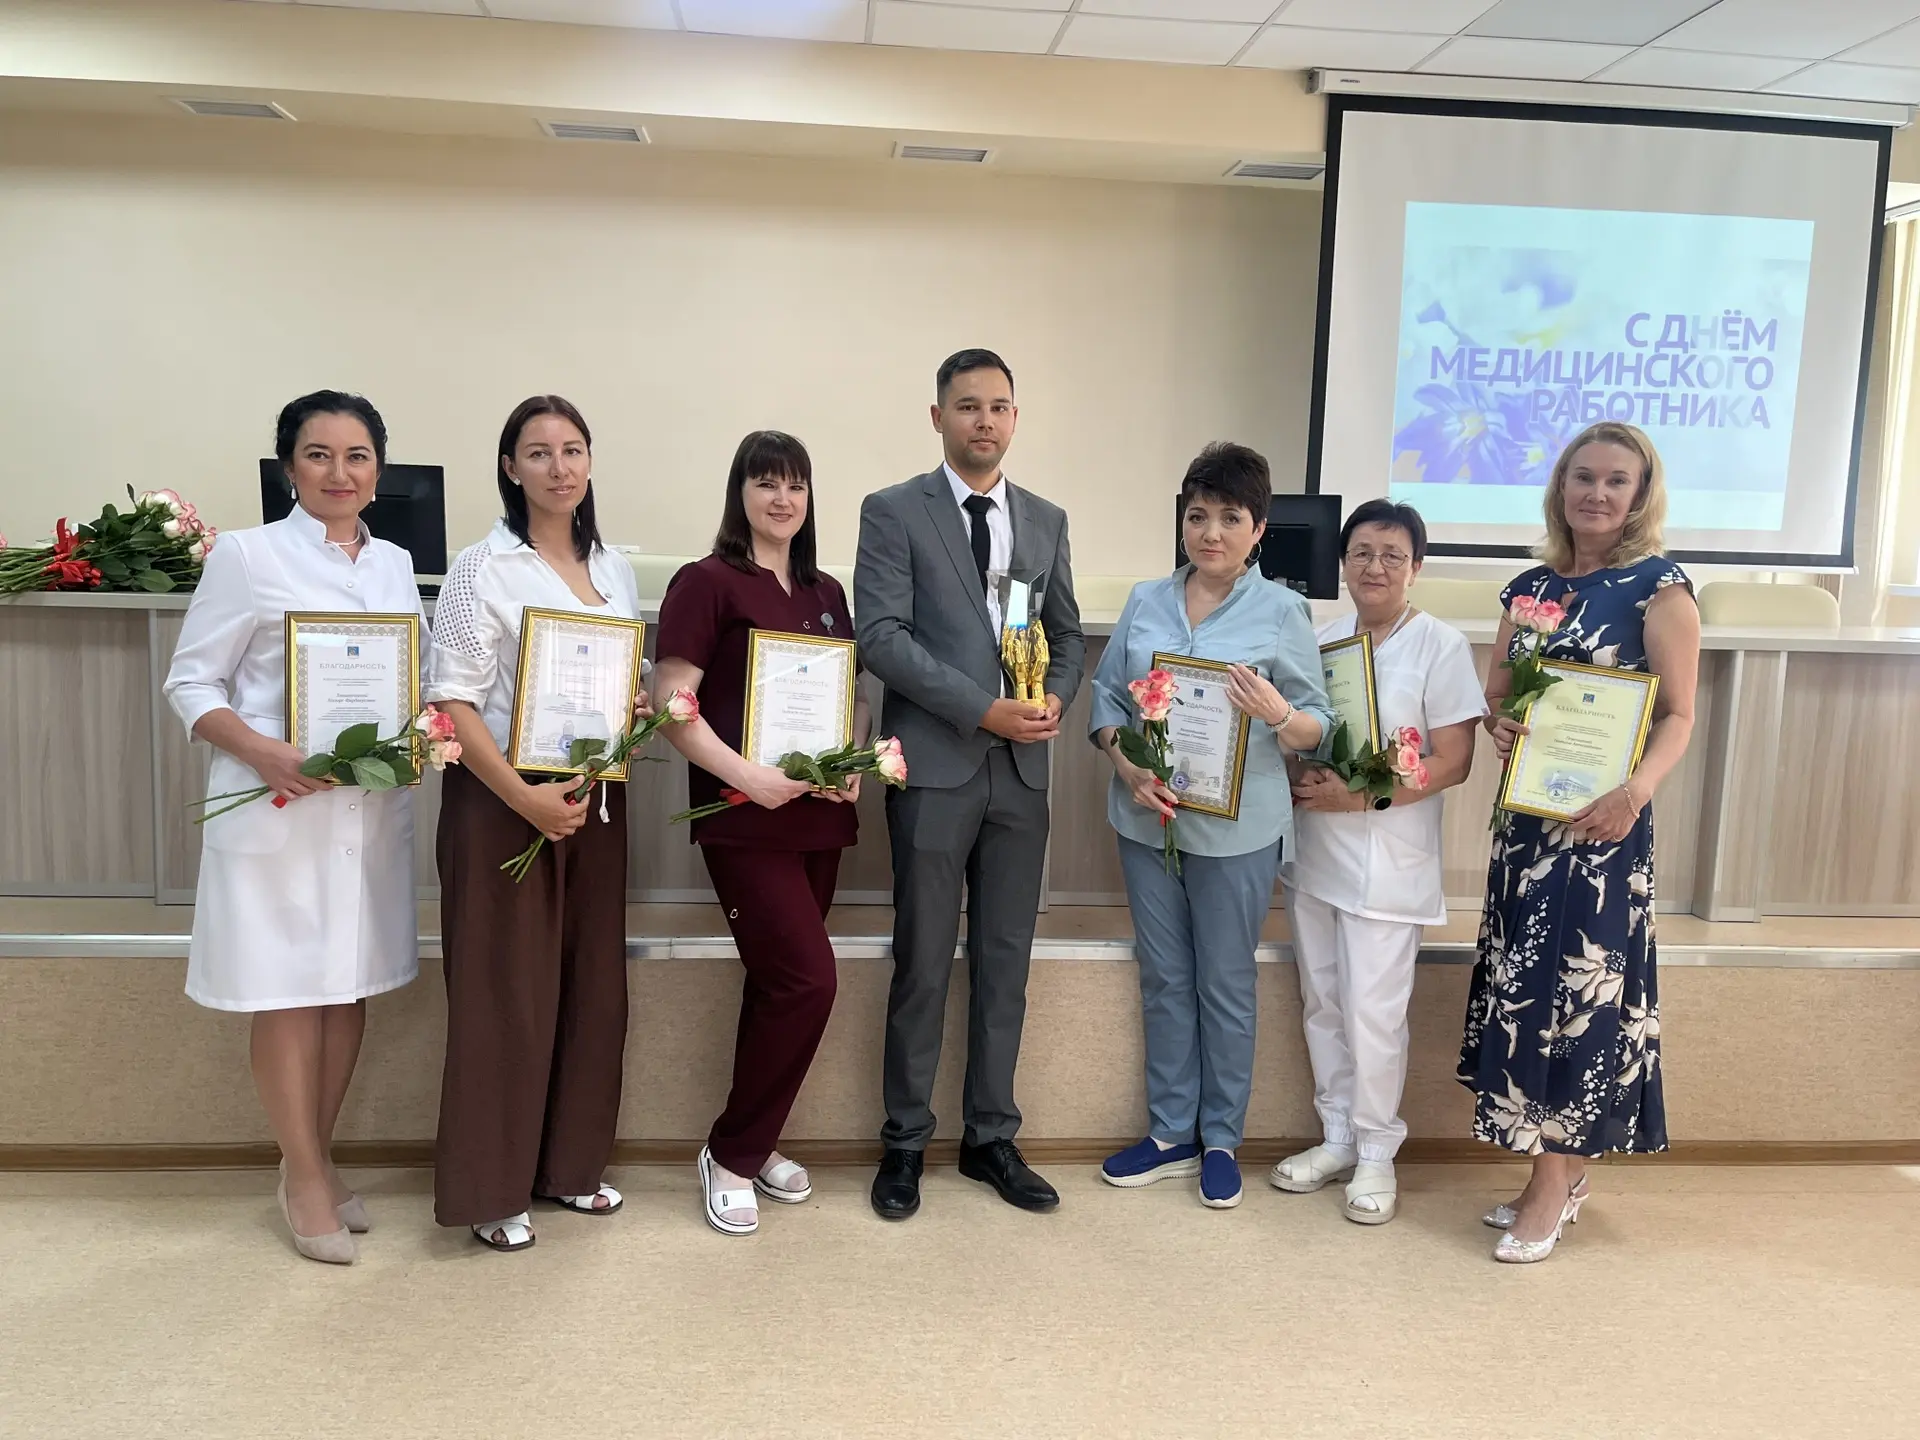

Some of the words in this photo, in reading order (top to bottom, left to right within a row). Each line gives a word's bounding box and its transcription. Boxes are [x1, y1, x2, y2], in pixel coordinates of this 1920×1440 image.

[1625, 312, 1651, 348] С
[1655, 309, 1778, 354] ДНЁМ
[1430, 346, 1774, 390] МЕДИЦИНСКОГО
[1530, 388, 1771, 429] РАБОТНИКА
[1171, 701, 1223, 714] БЛГОДАРНОСТЬ
